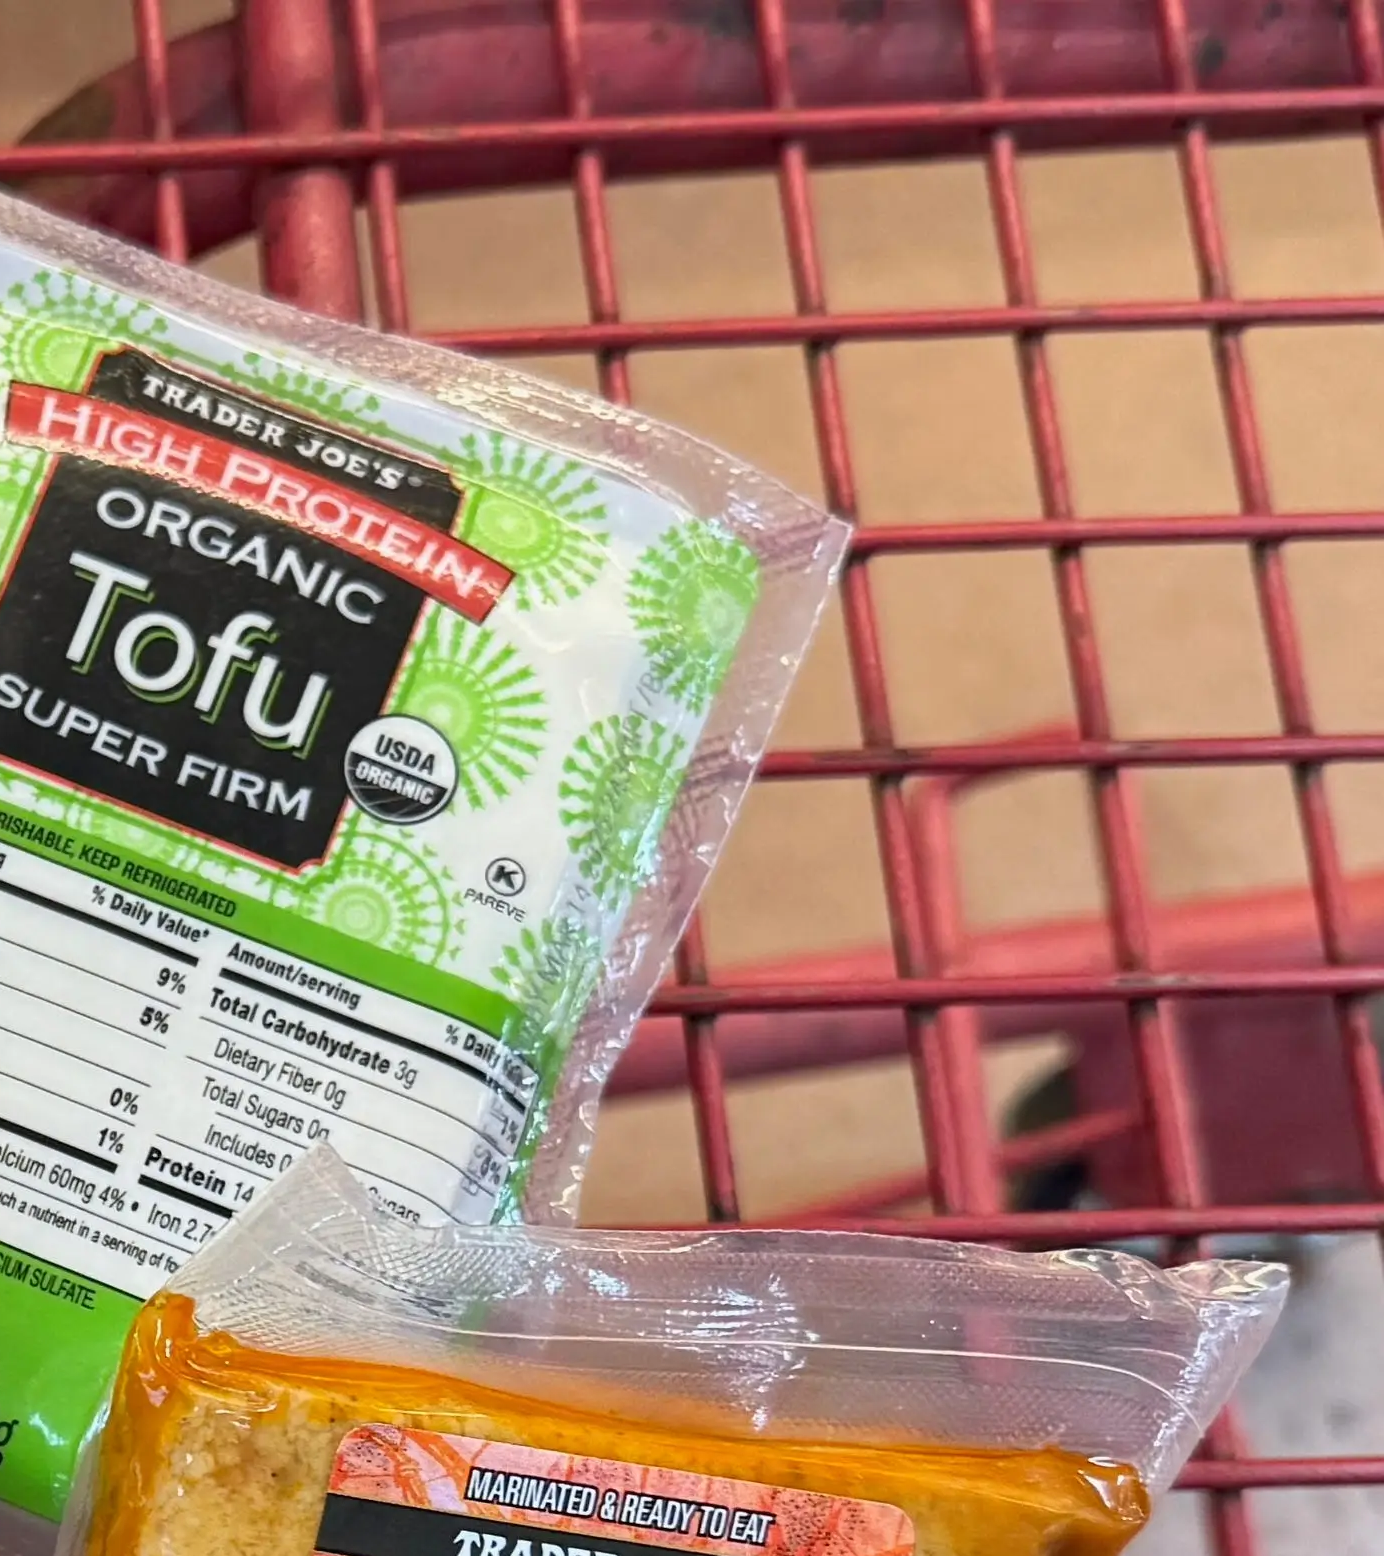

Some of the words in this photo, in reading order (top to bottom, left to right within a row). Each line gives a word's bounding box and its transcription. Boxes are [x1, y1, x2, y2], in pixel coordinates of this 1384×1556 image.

[141, 373, 287, 448] TRADER
[38, 397, 202, 475] HIGH
[218, 453, 483, 597] PROTEIN
[96, 487, 385, 625] ORGANIC
[65, 550, 329, 748] Tofu
[354, 759, 434, 807] ORGANIC
[375, 732, 437, 778] USDA
[177, 753, 312, 822] FIRM
[78, 844, 121, 873] KEEP
[121, 862, 236, 919] REFRIGERATED
[91, 885, 107, 906] %
[109, 892, 152, 926] Daily
[464, 888, 527, 924] PAREVE
[156, 966, 186, 994] 9%
[227, 942, 362, 1010] Amount/serving
[139, 1006, 170, 1034] 5%
[209, 988, 258, 1023] Total
[262, 1009, 391, 1075] Carbohydrate
[394, 1060, 418, 1090] 3g
[109, 1087, 140, 1116] 0%
[214, 1038, 275, 1082] Dietary
[278, 1066, 322, 1097] Fiber
[323, 1081, 347, 1111] 0g
[202, 1076, 245, 1113] Total
[245, 1093, 306, 1141] Sugars
[98, 1128, 125, 1154] 1%
[48, 1165, 97, 1203] 60mg
[99, 1184, 125, 1213] 4%
[144, 1146, 227, 1196] Protein
[147, 1202, 183, 1236] Iron
[465, 1467, 598, 1521] MARINATED
[599, 1495, 619, 1522] &
[619, 1492, 699, 1534] READY
[697, 1504, 729, 1539] TO
[729, 1512, 775, 1545] EAT
